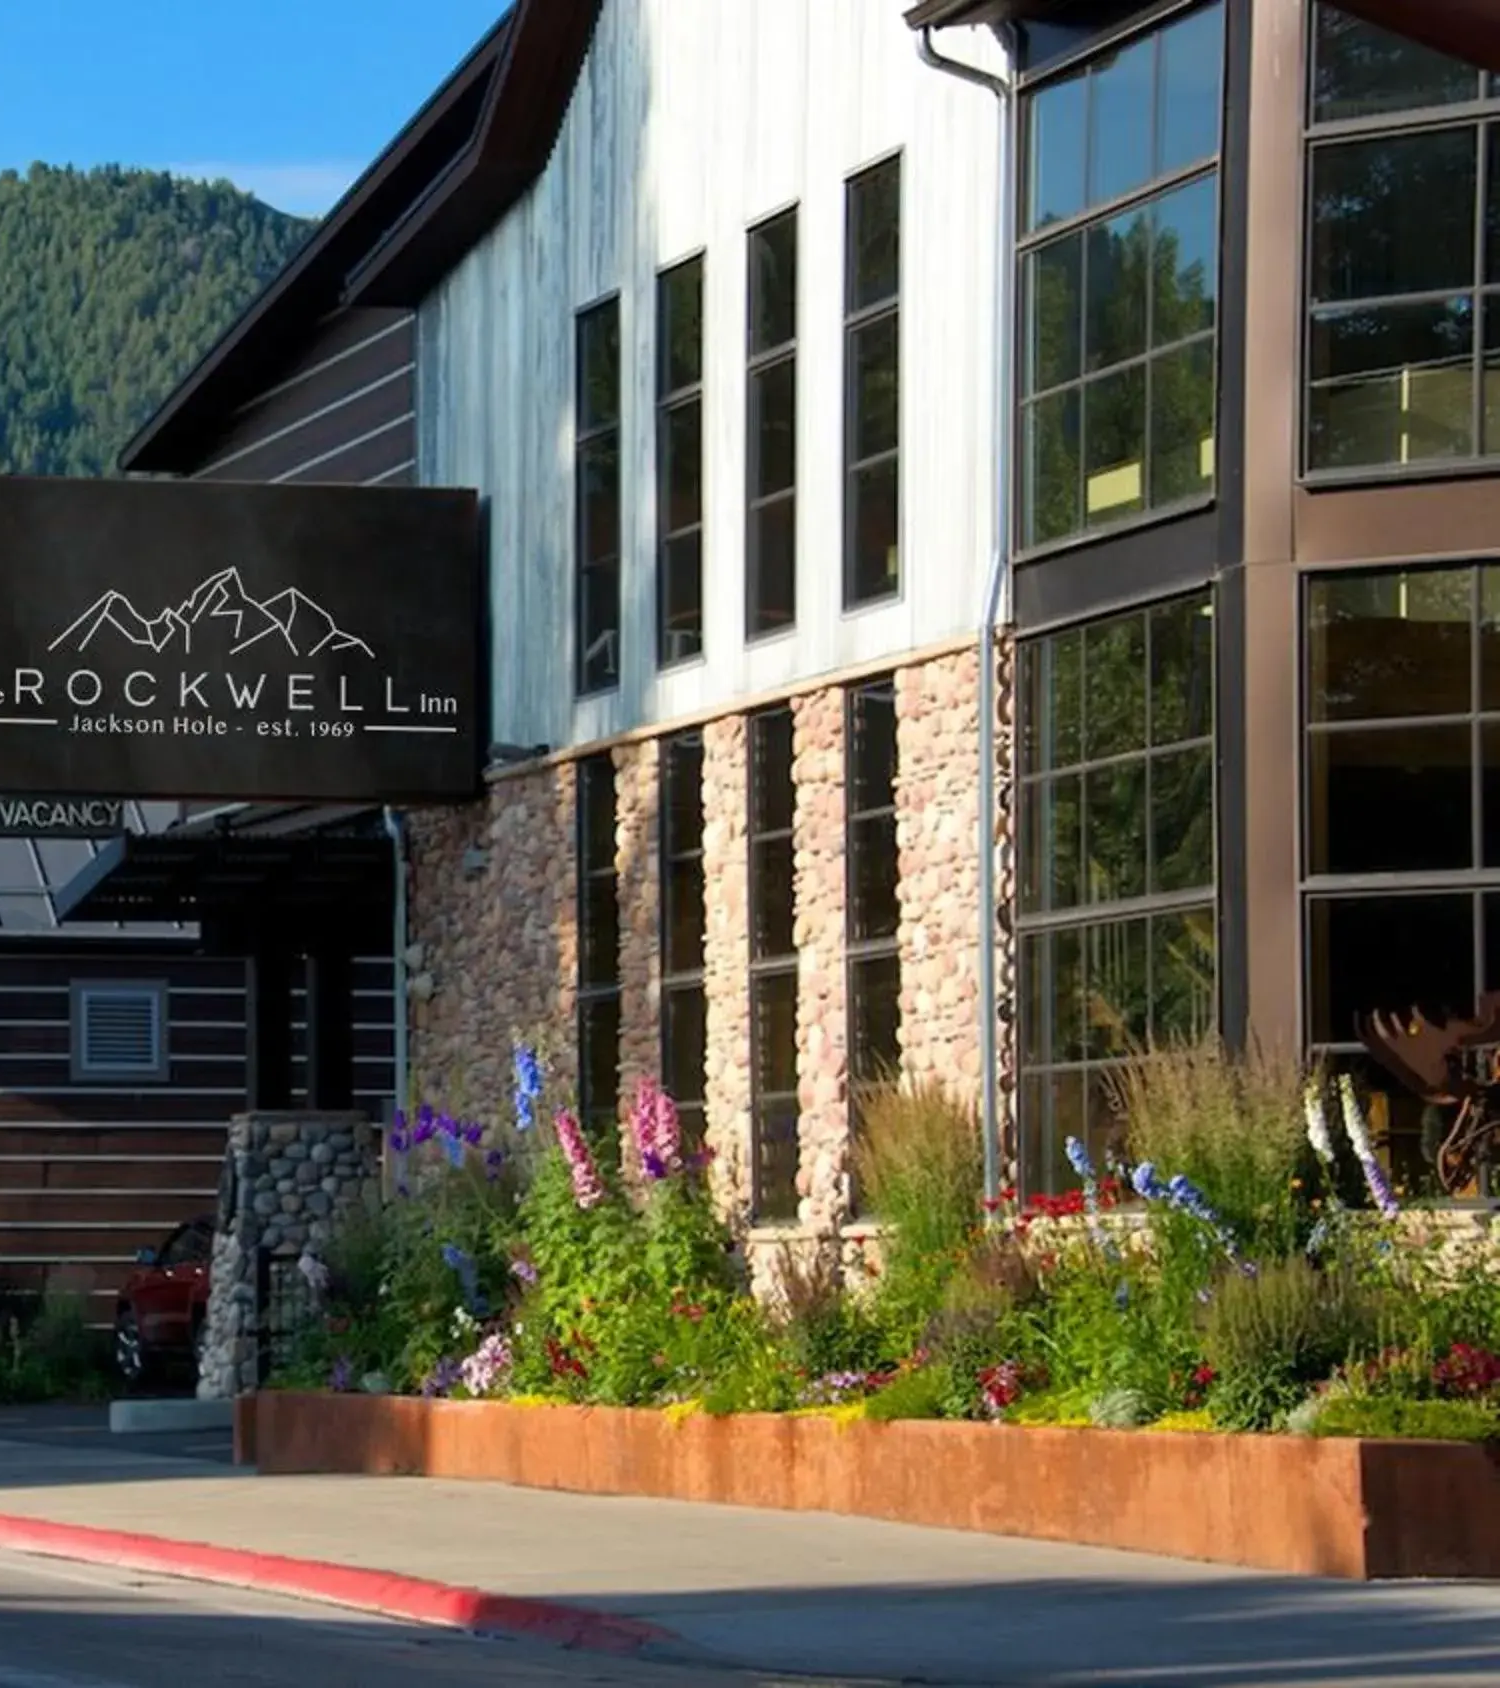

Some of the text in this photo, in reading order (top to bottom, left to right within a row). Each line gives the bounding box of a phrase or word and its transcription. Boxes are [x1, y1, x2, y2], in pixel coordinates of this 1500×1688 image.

[15, 668, 410, 712] ROCKWELL
[420, 693, 457, 714] Inn
[68, 713, 165, 734] Jackson
[173, 715, 227, 735] Hole
[256, 719, 299, 737] est.
[310, 721, 354, 737] 1969
